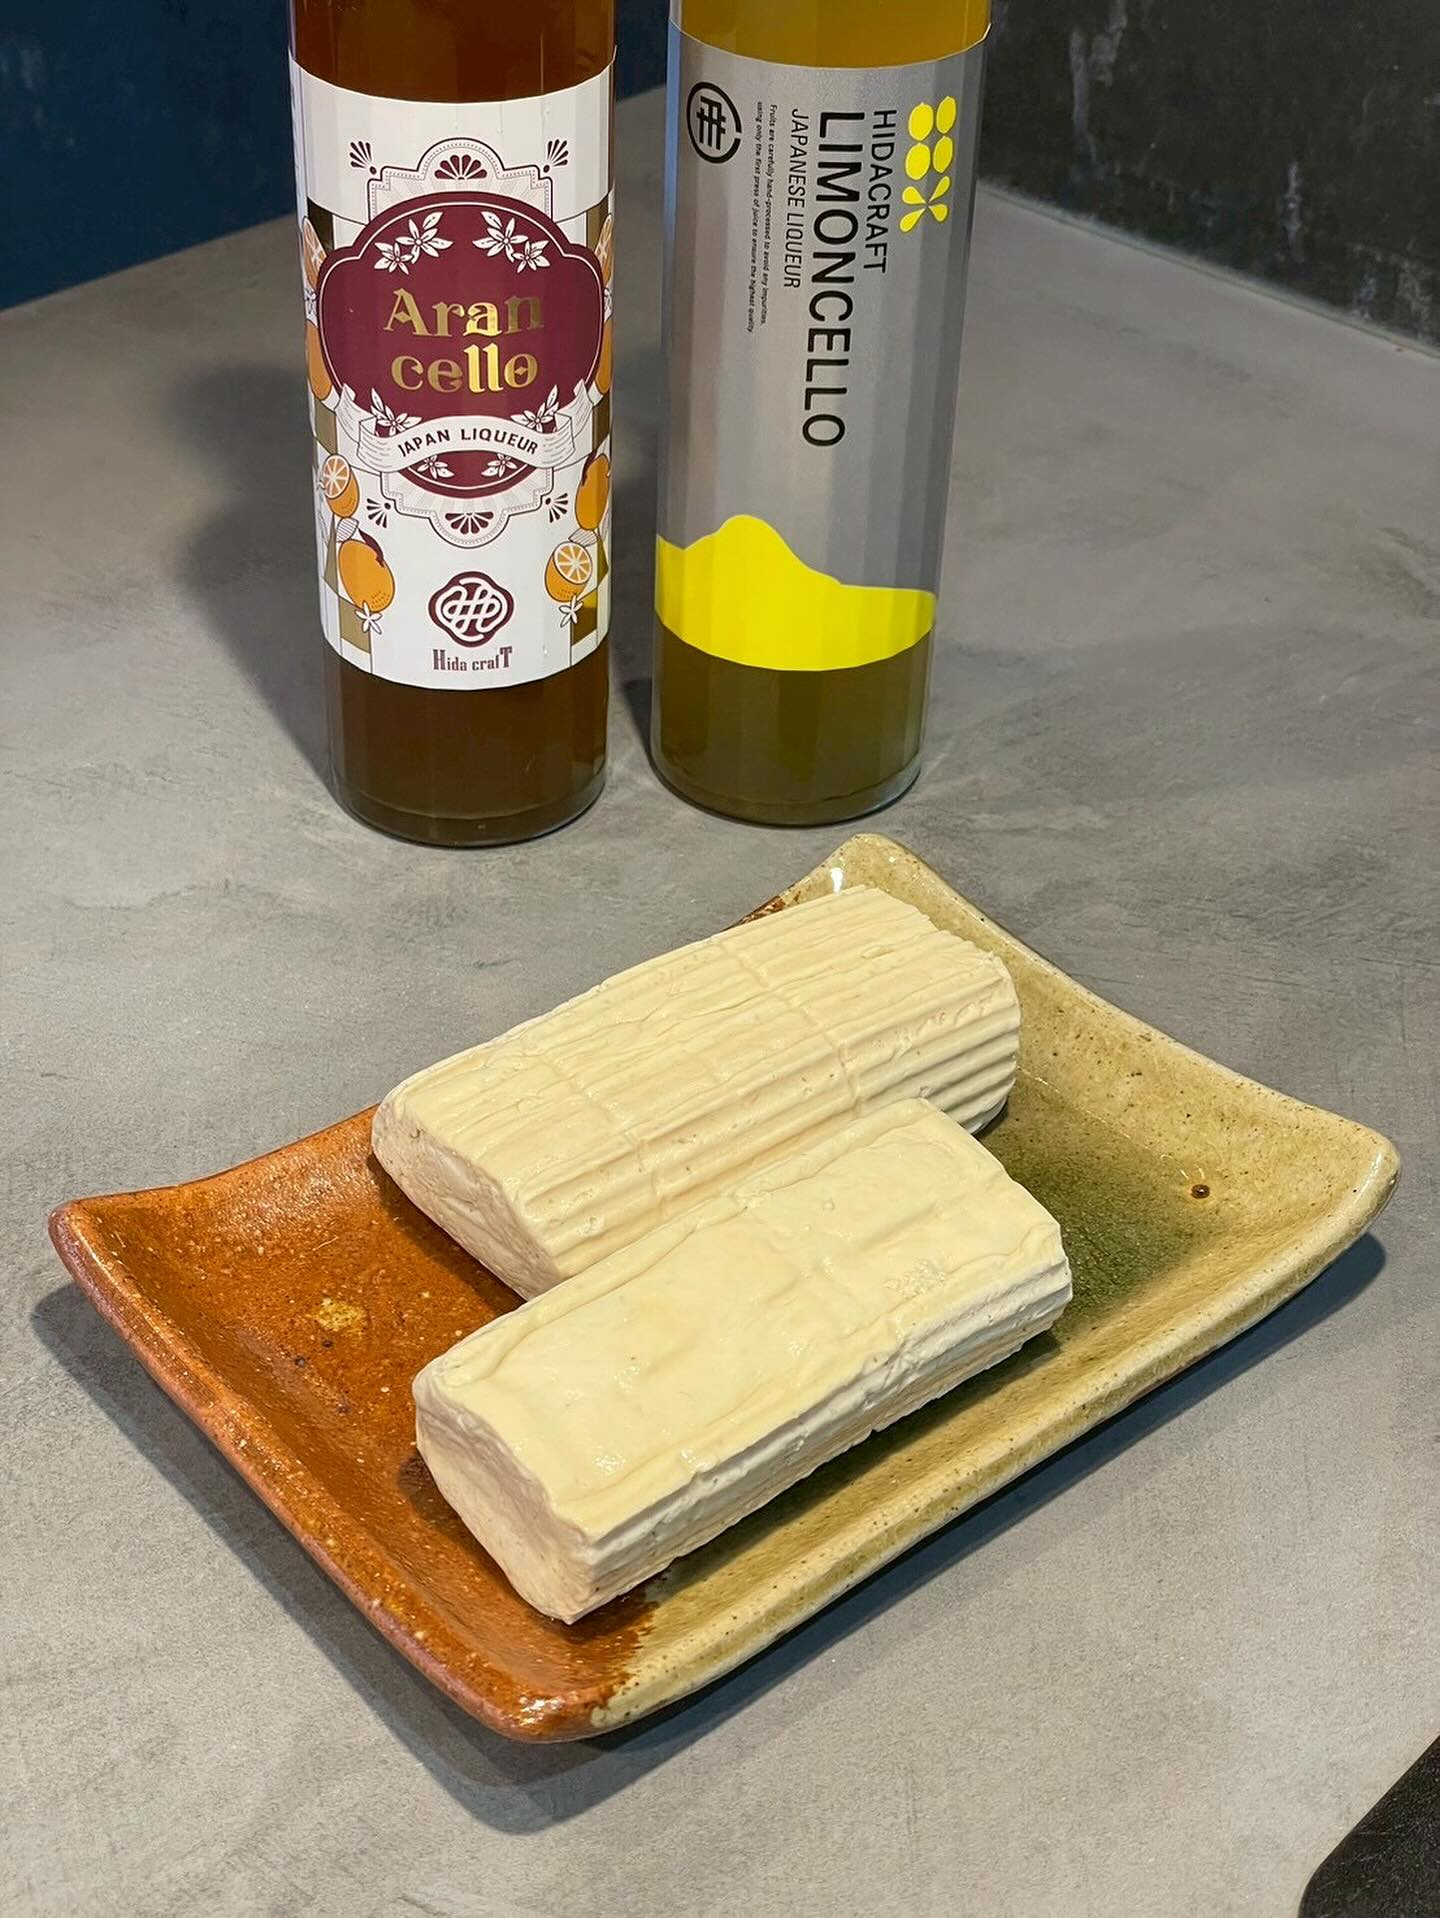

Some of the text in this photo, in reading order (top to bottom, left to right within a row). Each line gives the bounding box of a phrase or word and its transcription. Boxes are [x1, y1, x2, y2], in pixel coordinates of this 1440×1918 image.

[755, 102, 763, 122] using
[769, 104, 778, 127] Fruits
[754, 158, 762, 174] first
[766, 144, 776, 177] carefully
[754, 199, 760, 207] of
[783, 108, 809, 289] JAPANESE LIQUEUR
[863, 109, 897, 274] HIDACRAFT
[764, 179, 774, 240] hand-processed
[752, 229, 758, 237] to
[764, 242, 770, 250] to
[802, 111, 865, 447] LIMONCELLO
[383, 288, 544, 337] Aran
[391, 342, 538, 394] cello
[397, 428, 539, 458] JAPAN LIQUEUR
[432, 649, 467, 671] Hida
